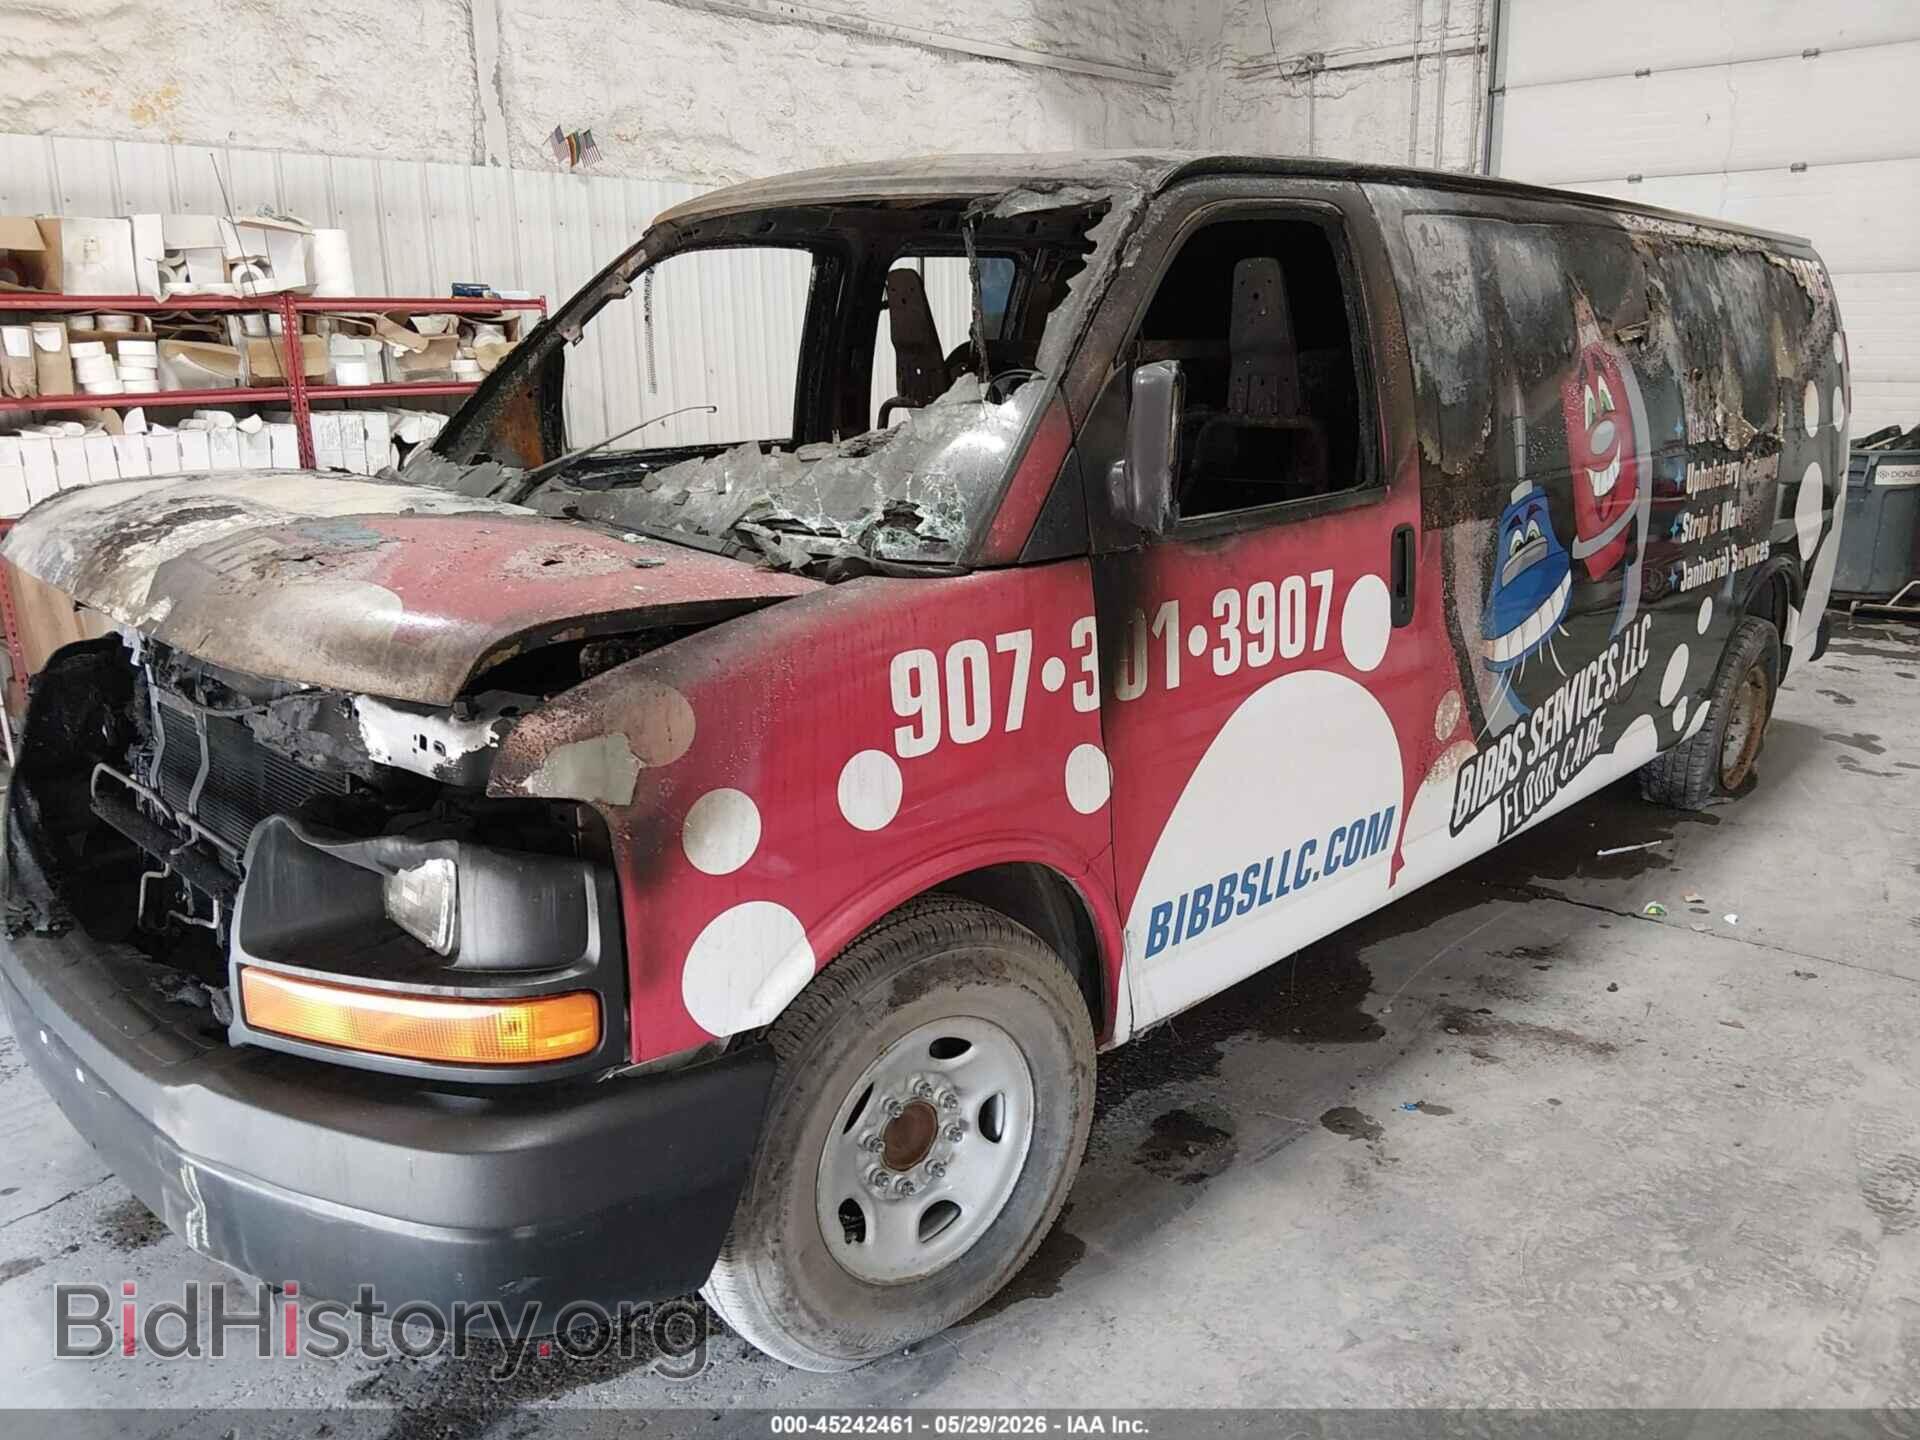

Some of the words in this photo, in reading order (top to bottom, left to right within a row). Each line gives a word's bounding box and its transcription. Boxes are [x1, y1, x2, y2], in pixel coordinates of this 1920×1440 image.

[1681, 508, 1708, 544] Strip
[1710, 504, 1719, 535] &
[1686, 459, 1741, 500] Upholstery
[1680, 547, 1730, 592] Janitorial
[1731, 537, 1770, 573] Services
[1453, 722, 1526, 828] BIBBS
[1527, 642, 1619, 765] SERVICES,
[1620, 613, 1651, 687] LLC
[1503, 751, 1558, 835] FLOOR
[1560, 708, 1608, 780] CARE
[1144, 805, 1396, 960] BIBBSLLC.COM
